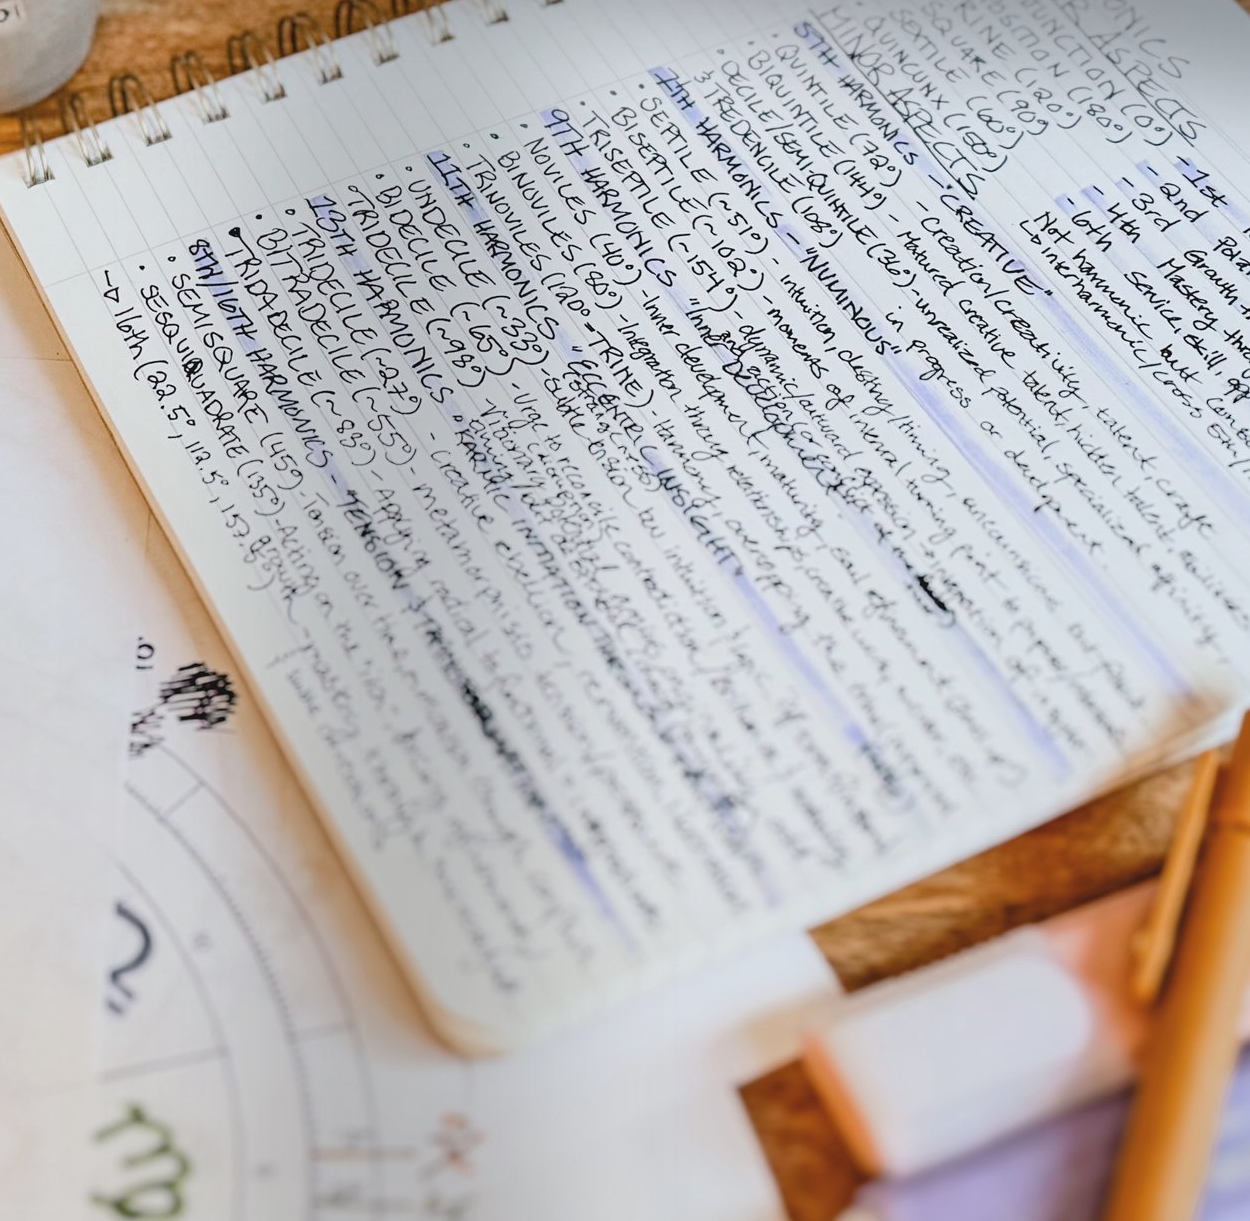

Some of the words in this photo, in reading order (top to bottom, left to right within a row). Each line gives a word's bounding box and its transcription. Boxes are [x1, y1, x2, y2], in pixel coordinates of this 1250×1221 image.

[773, 43, 860, 131] QUINTILE
[791, 19, 841, 69] 5TH
[836, 73, 919, 166] HARMONICS
[812, 3, 896, 87] MINOR
[878, 86, 986, 201] ASPECTS
[862, 15, 950, 111] QUINCUNX
[886, 7, 971, 84] SEXTILE
[918, 0, 1007, 88] SQUARE
[1087, 30, 1208, 141] ASPECTS
[522, 135, 597, 226] NOVILES
[542, 107, 590, 157] 9TH
[579, 165, 678, 288] HARMONICS
[581, 108, 676, 230] TRISEPTILE
[609, 105, 709, 214] BISEPTILE
[638, 95, 719, 184] SEPTILE
[1180, 168, 1229, 209] 1st
[346, 188, 436, 316] TRIDECILE
[406, 178, 497, 289] UNDECILE
[425, 151, 478, 210] 11TH
[471, 217, 560, 341] HARMONICS
[464, 160, 552, 272] TRINOVILES
[495, 149, 583, 263] BINOVILES
[694, 115, 784, 229] HARMONICS
[798, 245, 903, 356] "NUMINOUS"
[703, 80, 806, 194] TREDENCILE
[883, 304, 904, 334] in
[904, 338, 972, 409] progress
[1069, 209, 1113, 253] 6th
[1130, 191, 1182, 233] 3rd
[1182, 248, 1239, 306] Growth
[1157, 181, 1210, 224] 2nd
[223, 232, 323, 387] TRIDADECILE
[254, 226, 367, 385] BITRADECILE
[290, 220, 379, 346] TRIDECILE
[302, 194, 358, 257] 13TH
[351, 267, 455, 405] HARMONICS
[373, 183, 458, 293] BIDECILE
[542, 432, 563, 452] to
[746, 48, 846, 159] BIQUINTILE
[895, 229, 966, 298] Matured
[957, 298, 1016, 370] creative
[1064, 422, 1122, 487] hidden
[1031, 209, 1075, 245] Not
[1070, 247, 1154, 340] harmonic
[1105, 201, 1141, 245] 4th
[1154, 256, 1219, 332] Mastery
[112, 305, 150, 361] 16th
[170, 272, 269, 424] SEMISQUARE
[244, 346, 334, 469] HARMONICS
